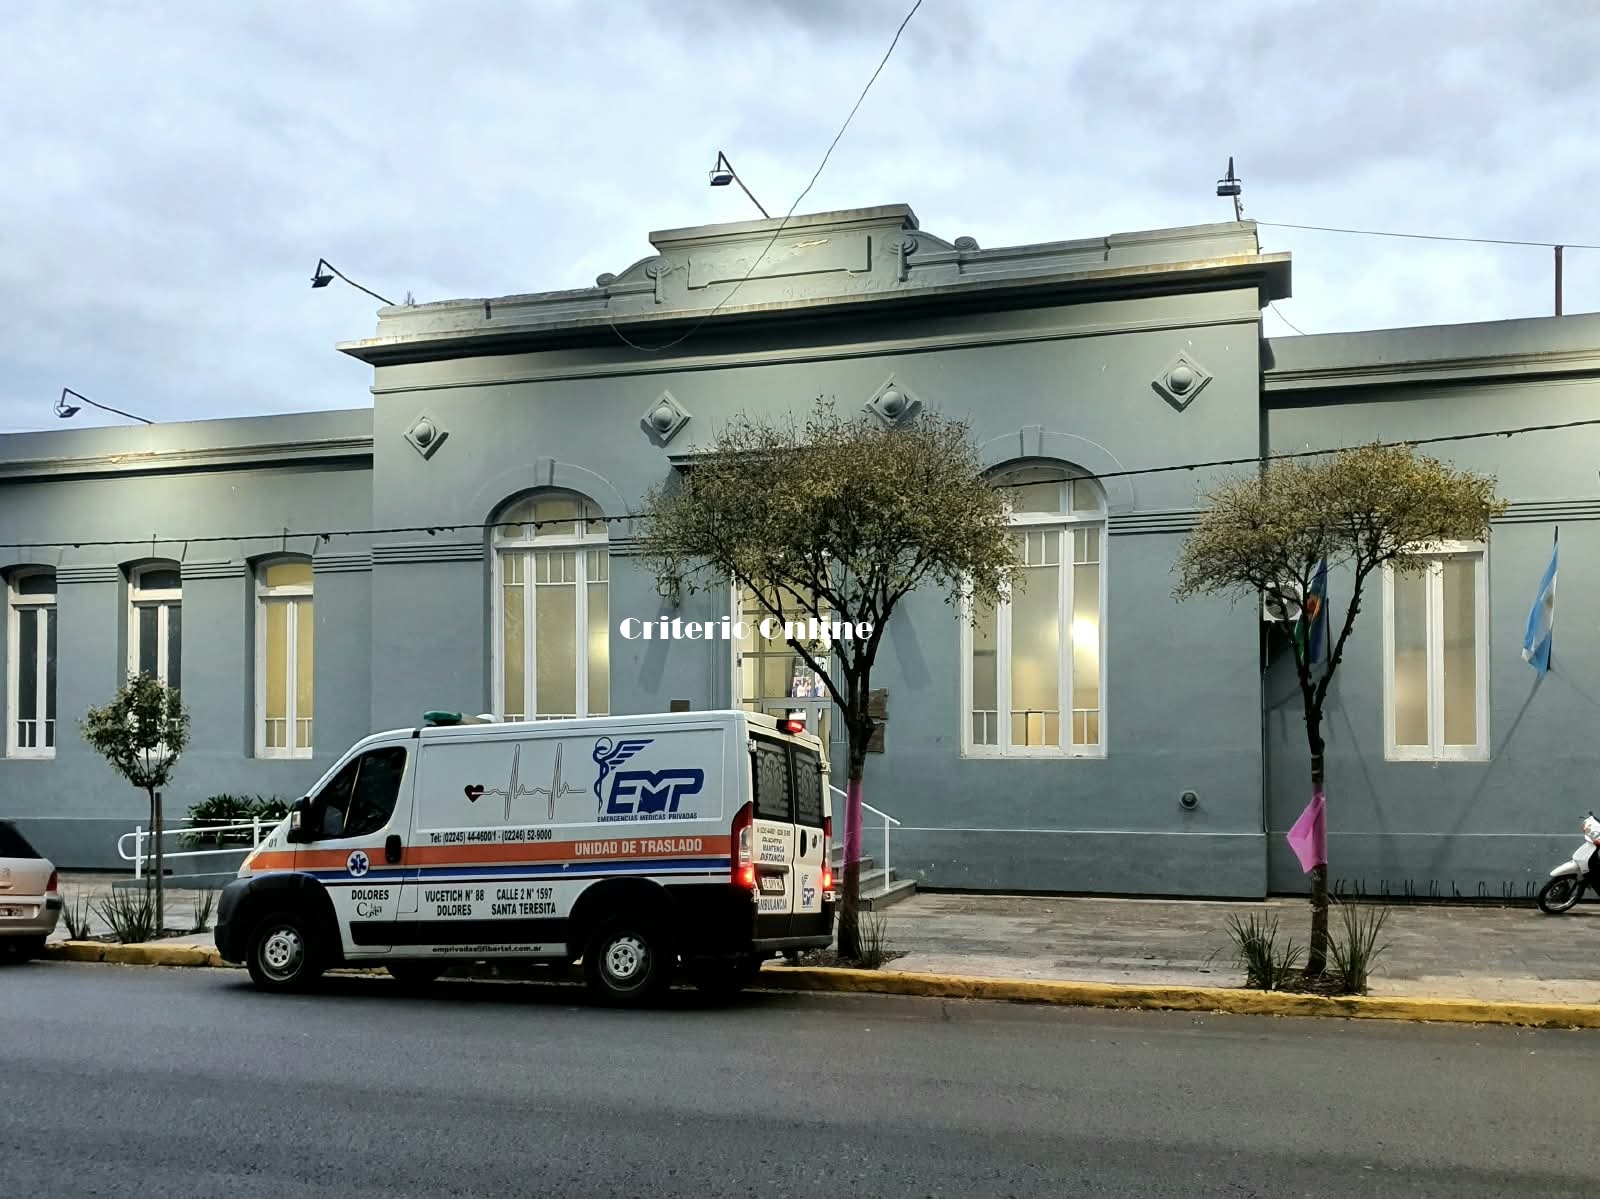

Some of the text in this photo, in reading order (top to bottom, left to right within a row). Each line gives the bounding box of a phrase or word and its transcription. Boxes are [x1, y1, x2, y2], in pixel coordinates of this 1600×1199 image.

[607, 768, 705, 814] EMP
[597, 815, 638, 823] EMERGENCIAS
[668, 812, 698, 820] PRIVADAS
[527, 829, 552, 841] 52-9000
[575, 838, 702, 856] UNIDAD DE TRASLADO
[762, 844, 785, 853] MANTENGA
[760, 853, 785, 863] DISTANCIA
[351, 889, 389, 900] DOLORES
[425, 889, 463, 902] VUCETICH
[475, 889, 485, 901] 88
[496, 888, 519, 900] CALLE
[520, 888, 525, 900] 2
[536, 887, 553, 900] 1597
[437, 904, 472, 916] DOLORES
[491, 902, 556, 915] SANTA TERESITA
